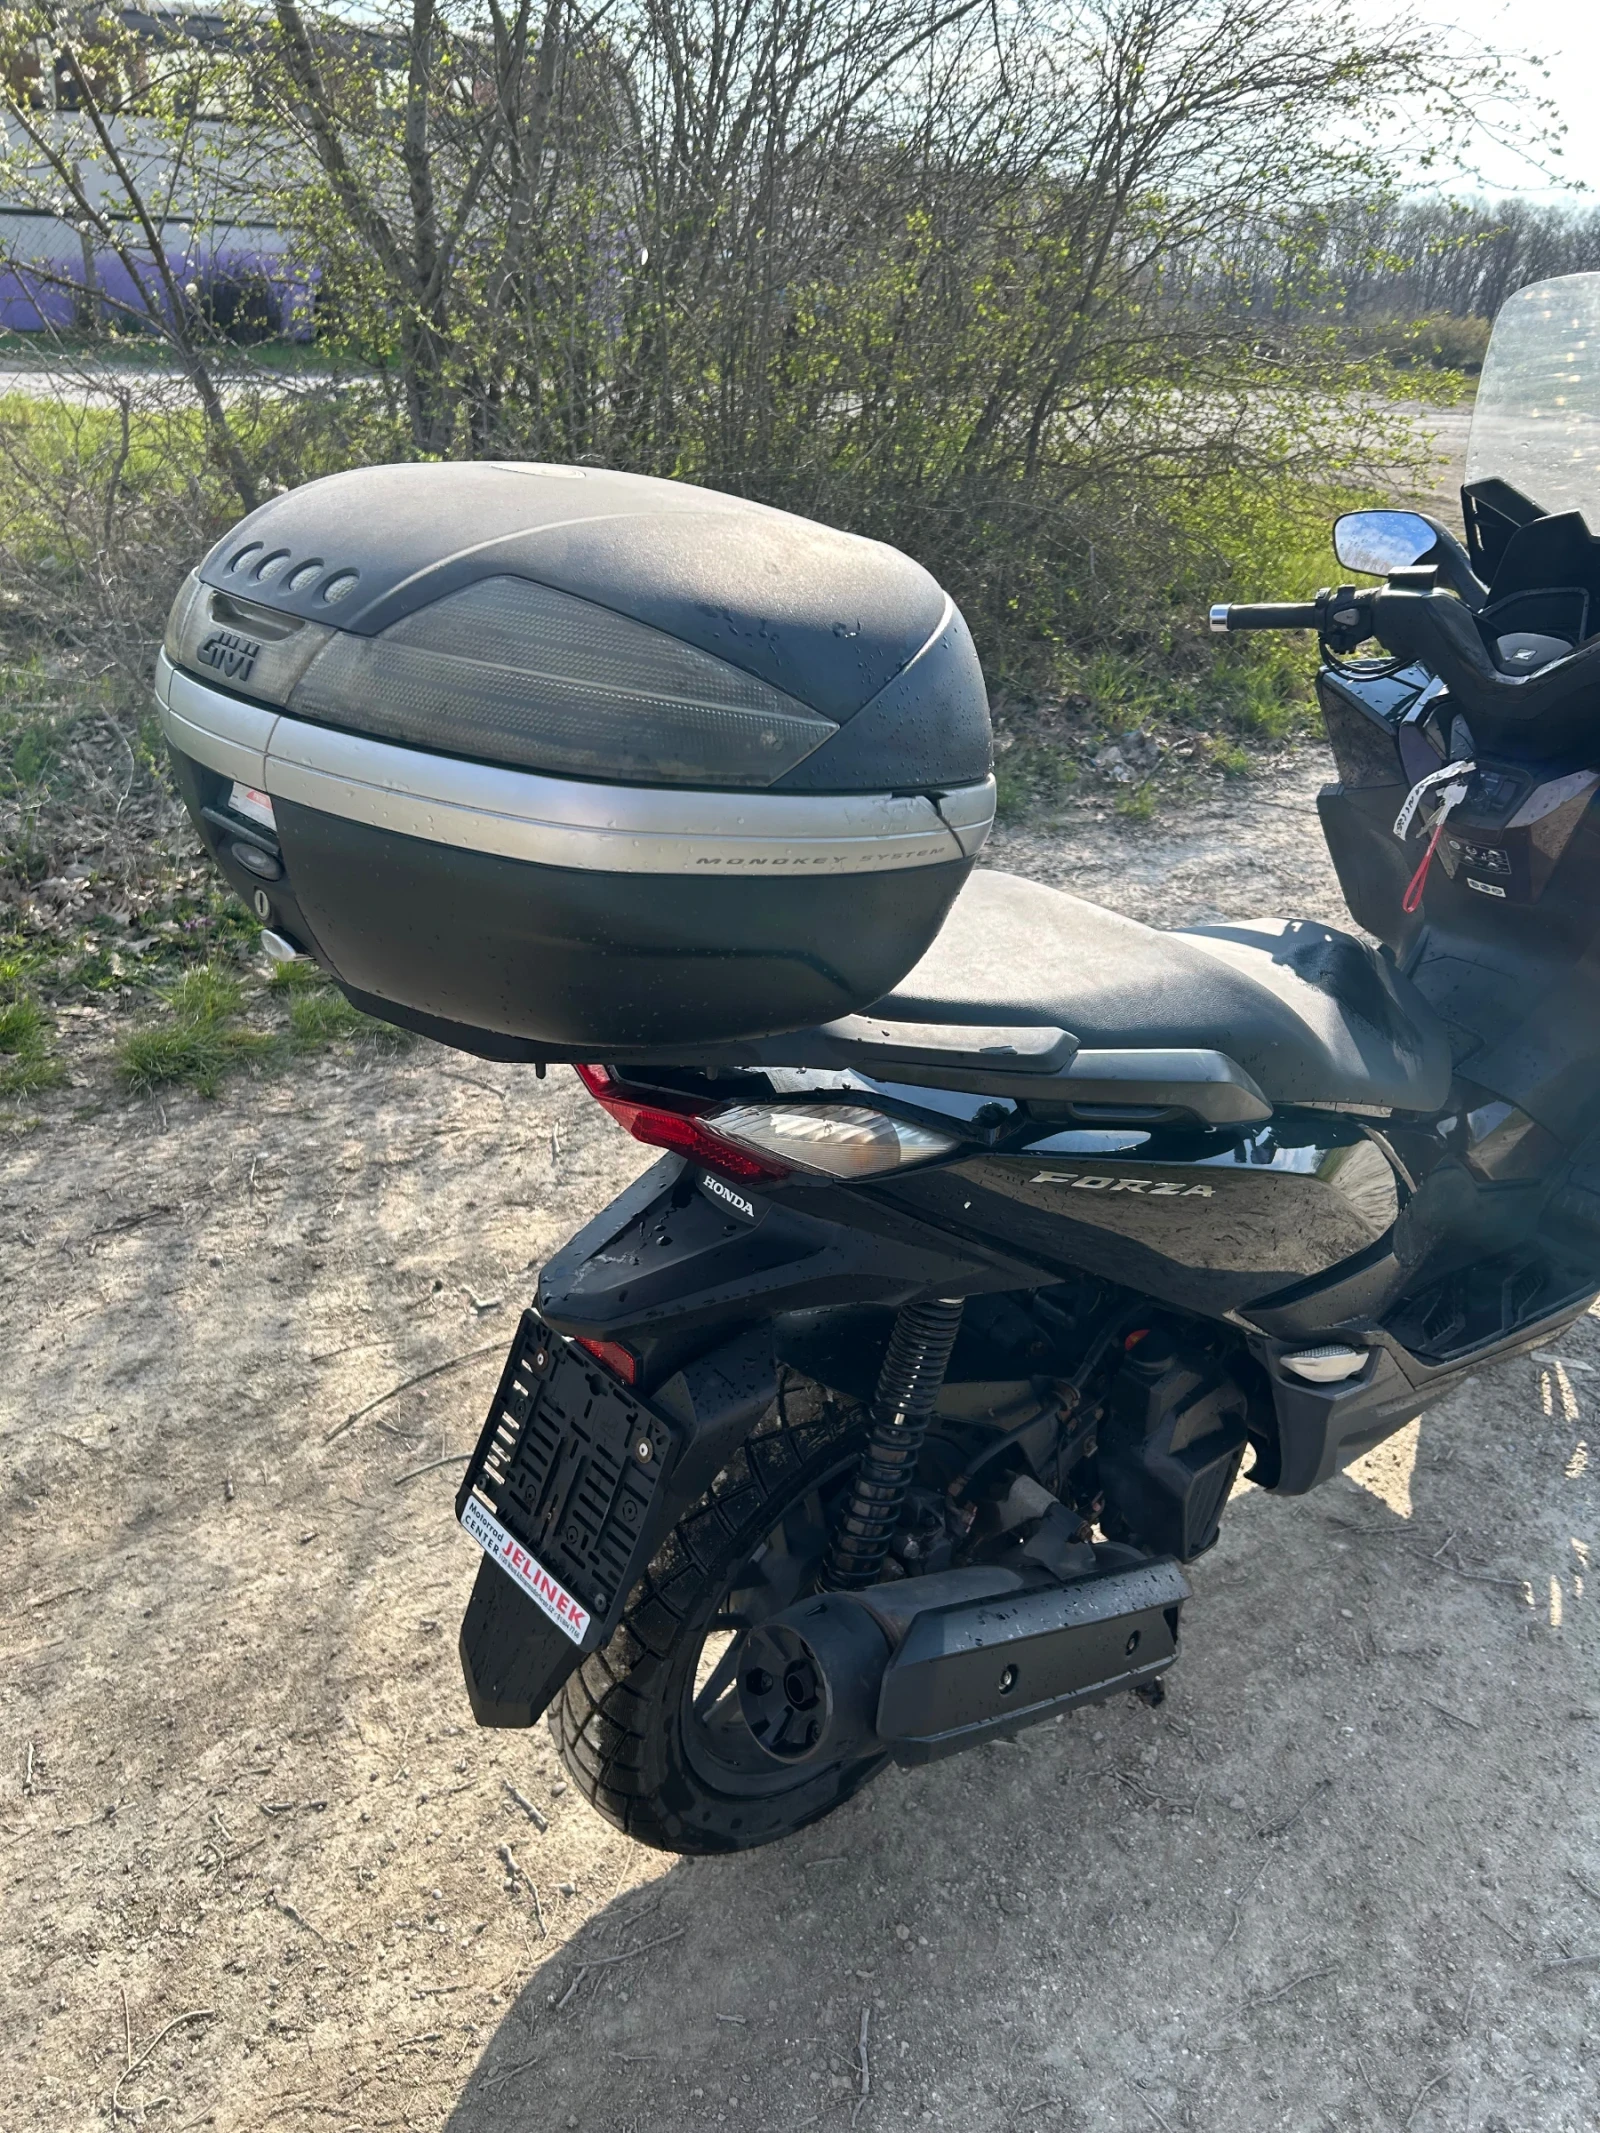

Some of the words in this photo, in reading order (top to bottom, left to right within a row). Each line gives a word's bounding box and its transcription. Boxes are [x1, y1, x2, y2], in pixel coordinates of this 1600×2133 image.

[197, 631, 260, 681] GIVI
[696, 855, 848, 866] MONOKEY
[859, 847, 945, 863] SYSTEM
[703, 1175, 754, 1217] HONDA
[1029, 1170, 1216, 1197] FORZA
[465, 1515, 499, 1555] CENTER
[469, 1502, 504, 1542] Motorrad
[502, 1541, 586, 1630] JELINEK
